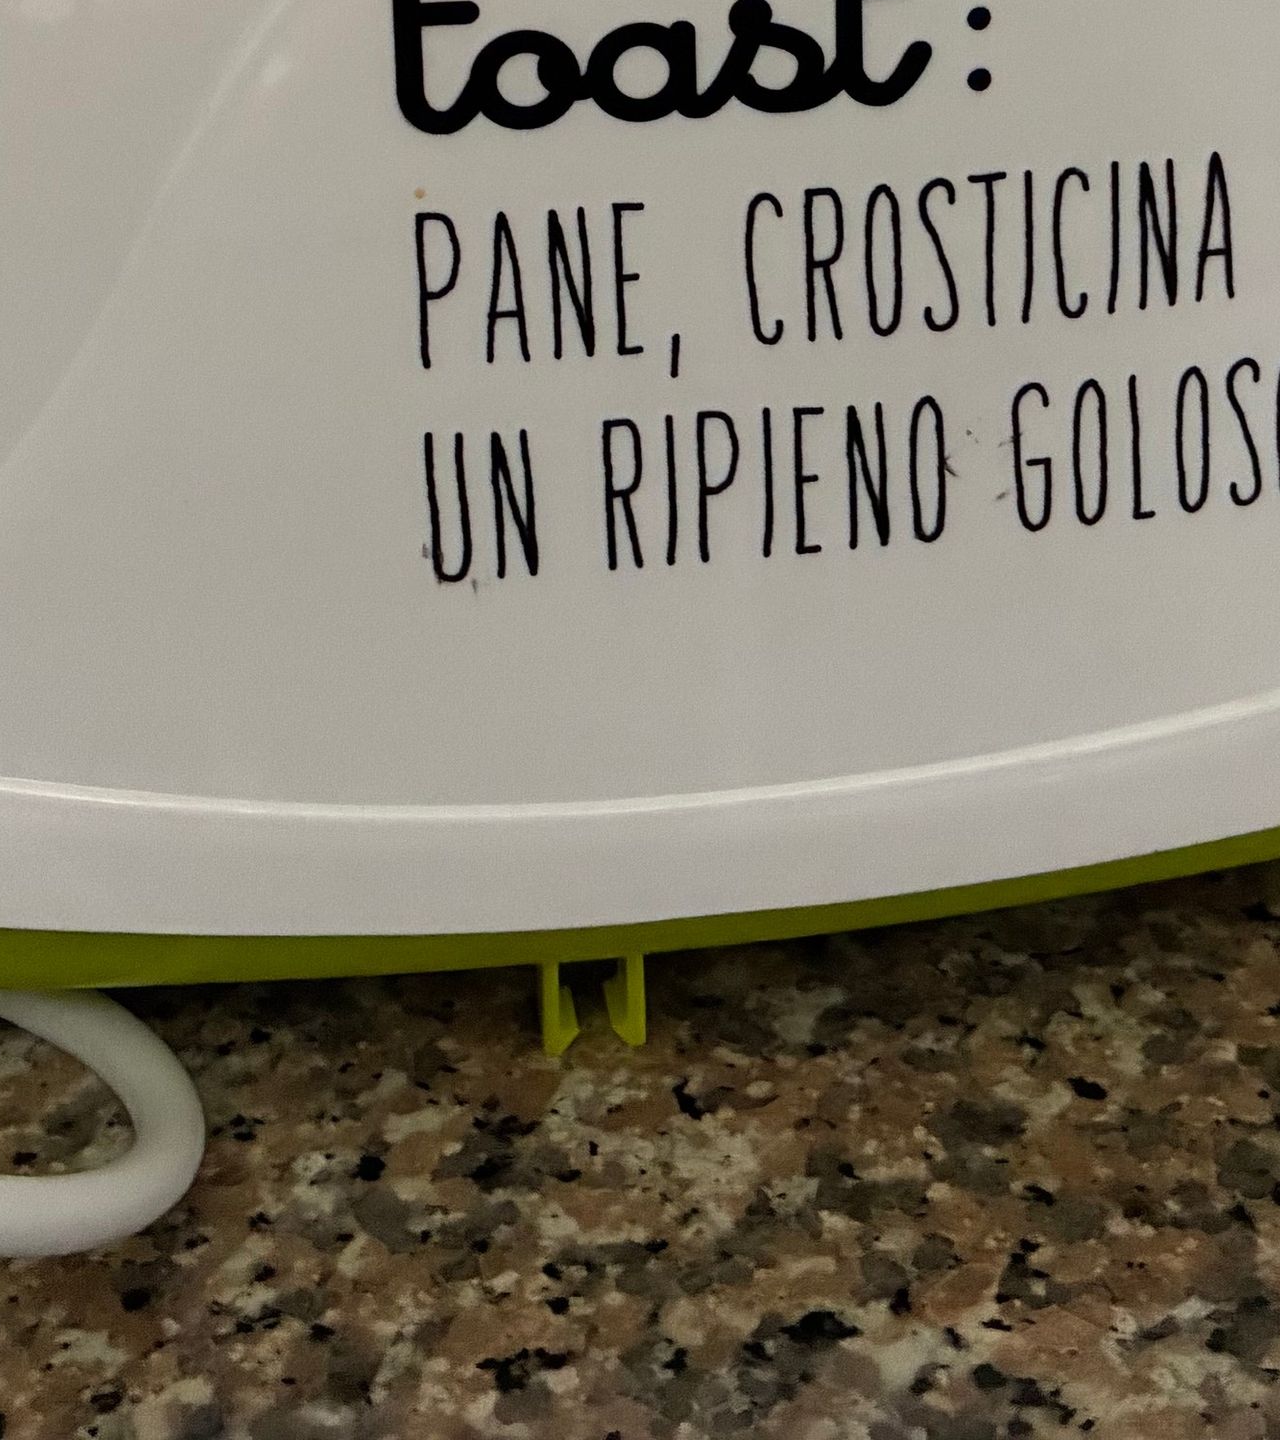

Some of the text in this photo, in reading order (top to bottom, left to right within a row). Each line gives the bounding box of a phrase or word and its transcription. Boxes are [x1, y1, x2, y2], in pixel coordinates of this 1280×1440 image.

[413, 201, 682, 380] PANE,
[743, 150, 1237, 347] CROSTICINA
[422, 428, 540, 585] UN
[601, 394, 957, 572] RIPIENO
